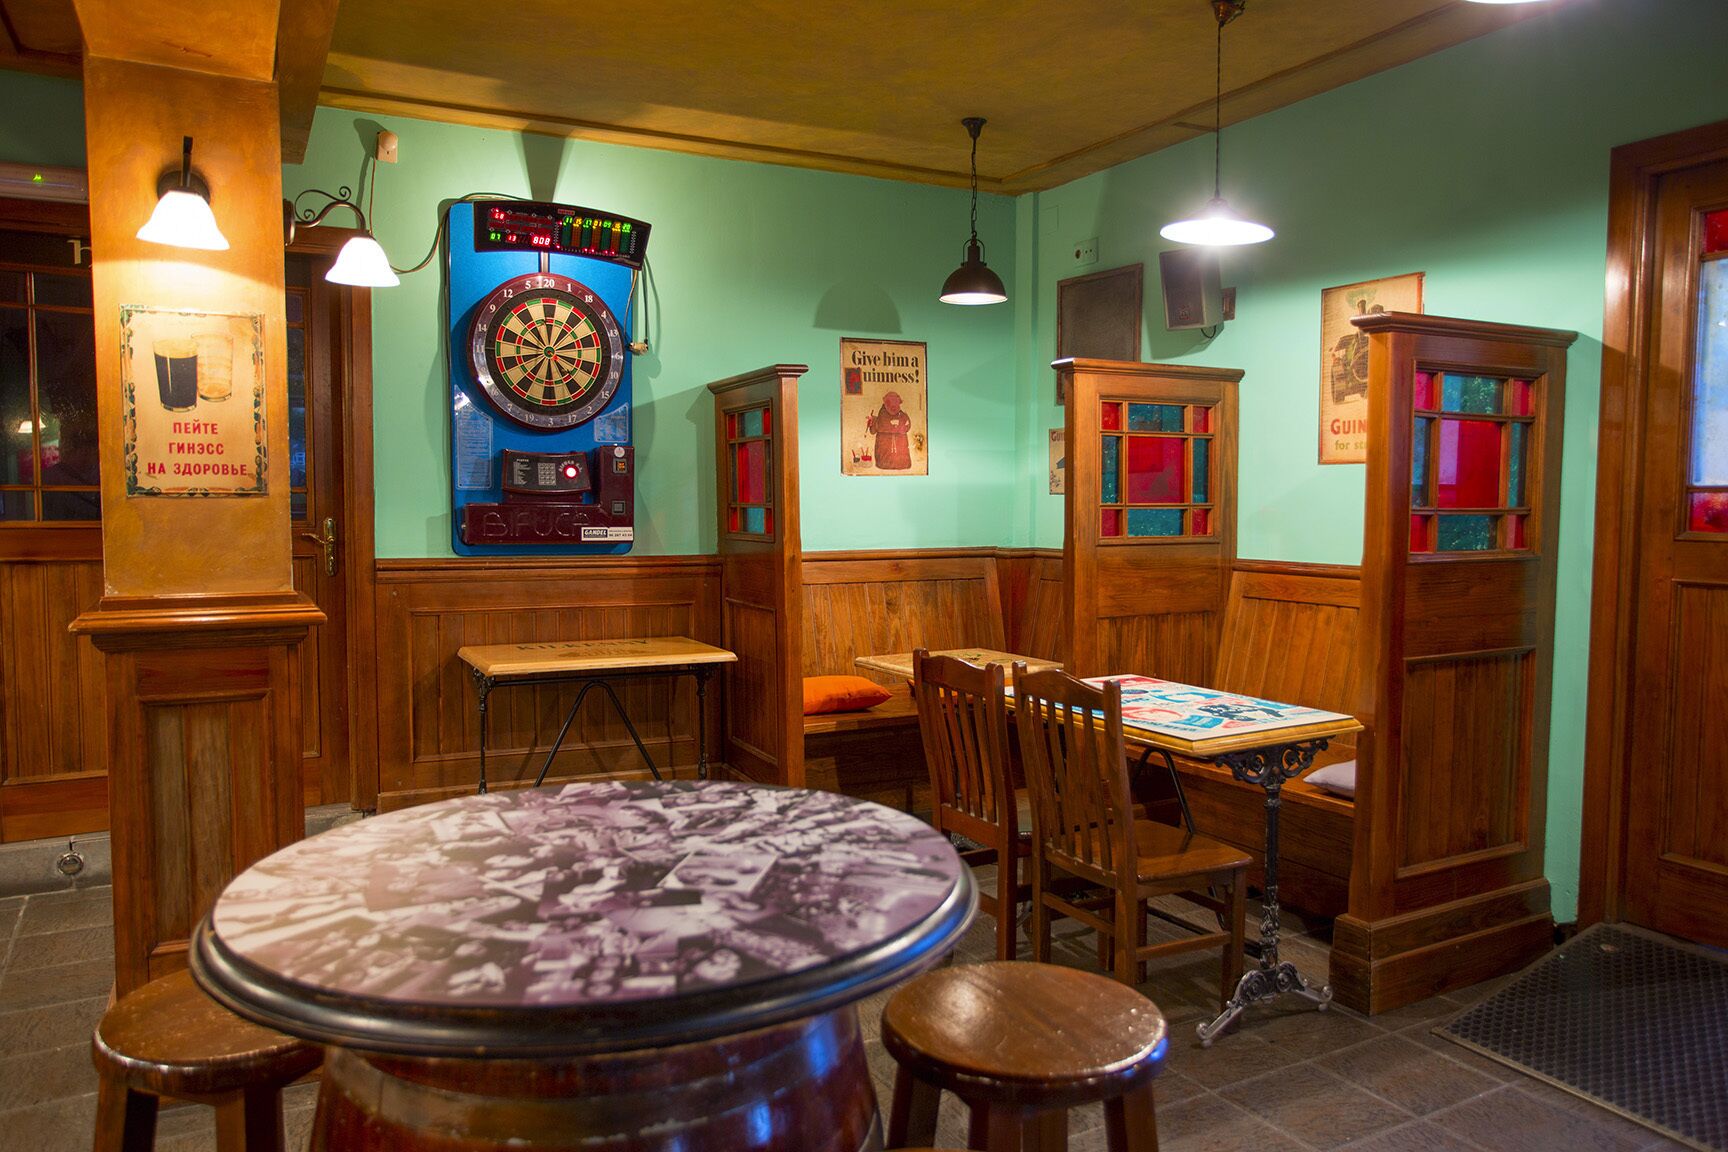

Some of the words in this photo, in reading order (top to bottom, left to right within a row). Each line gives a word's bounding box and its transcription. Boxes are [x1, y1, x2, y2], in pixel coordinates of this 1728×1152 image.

[525, 280, 531, 290] 5
[543, 278, 555, 288] 20
[567, 283, 572, 292] 1
[503, 289, 513, 298] 12
[584, 294, 594, 303] 18
[489, 304, 496, 313] 9
[600, 310, 607, 319] 4
[478, 323, 487, 332] 14
[610, 329, 618, 338] 13
[614, 351, 621, 360] 6
[852, 350, 881, 366] Give
[883, 351, 909, 368] him
[911, 355, 919, 368] a
[610, 371, 619, 379] 10
[601, 390, 610, 400] 15
[587, 405, 593, 415] 2
[525, 413, 535, 423] 19
[568, 414, 577, 424] 17
[173, 418, 218, 435] ПЕЙТЕ
[168, 442, 224, 455] ГИНЭСС
[1335, 440, 1351, 451] for
[147, 462, 166, 475] НА
[173, 463, 248, 477] ЗДОРОВЬЕ
